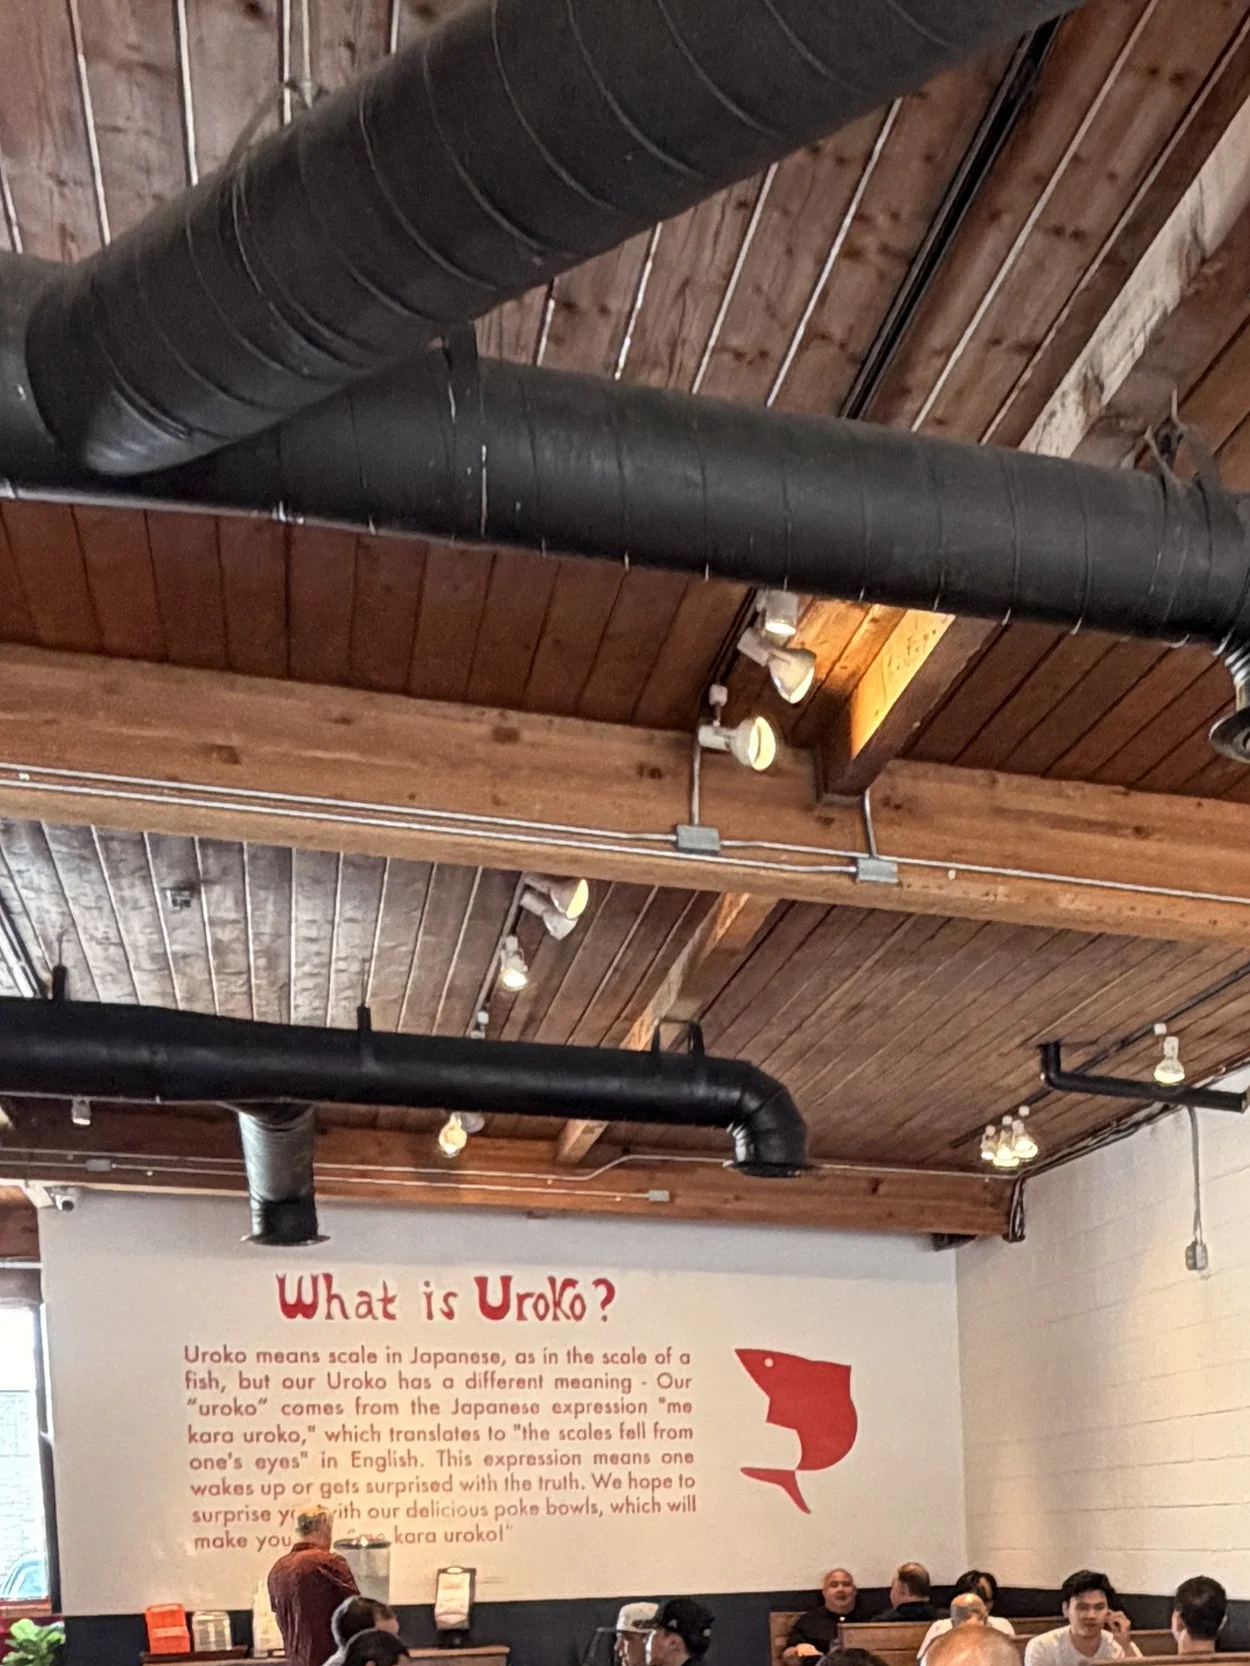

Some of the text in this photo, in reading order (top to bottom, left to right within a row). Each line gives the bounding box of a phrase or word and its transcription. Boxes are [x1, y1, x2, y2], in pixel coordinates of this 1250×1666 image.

[275, 1271, 398, 1321] What
[422, 1280, 459, 1321] is
[184, 1344, 690, 1370] Uroko means scale in Japanese, as in the scale of a
[185, 1369, 226, 1393] fish,
[238, 1370, 270, 1390] but
[282, 1377, 316, 1390] our
[327, 1371, 387, 1390] Uroko
[398, 1370, 431, 1390] has
[442, 1377, 454, 1389] a
[465, 1370, 543, 1389] different
[554, 1372, 632, 1394] meaning
[657, 1372, 692, 1389] Our
[187, 1396, 692, 1420] "uroko" comes from the Japanese expression "me
[188, 1421, 693, 1446] kara uroko," which translates to "the scales fell from
[189, 1448, 694, 1475] one's eyes" in English. This expression means one
[190, 1471, 695, 1500] wakes up or gets surprised with the truth. We hope to
[192, 1505, 271, 1528] surprise
[333, 1500, 361, 1519] ith
[367, 1507, 400, 1519] our
[406, 1500, 488, 1518] delicious
[495, 1498, 539, 1521] poke
[546, 1496, 603, 1517] bowls,
[610, 1494, 662, 1514] which
[667, 1493, 697, 1512] will
[194, 1529, 247, 1550] make
[256, 1534, 292, 1552] you
[393, 1524, 437, 1544] kara
